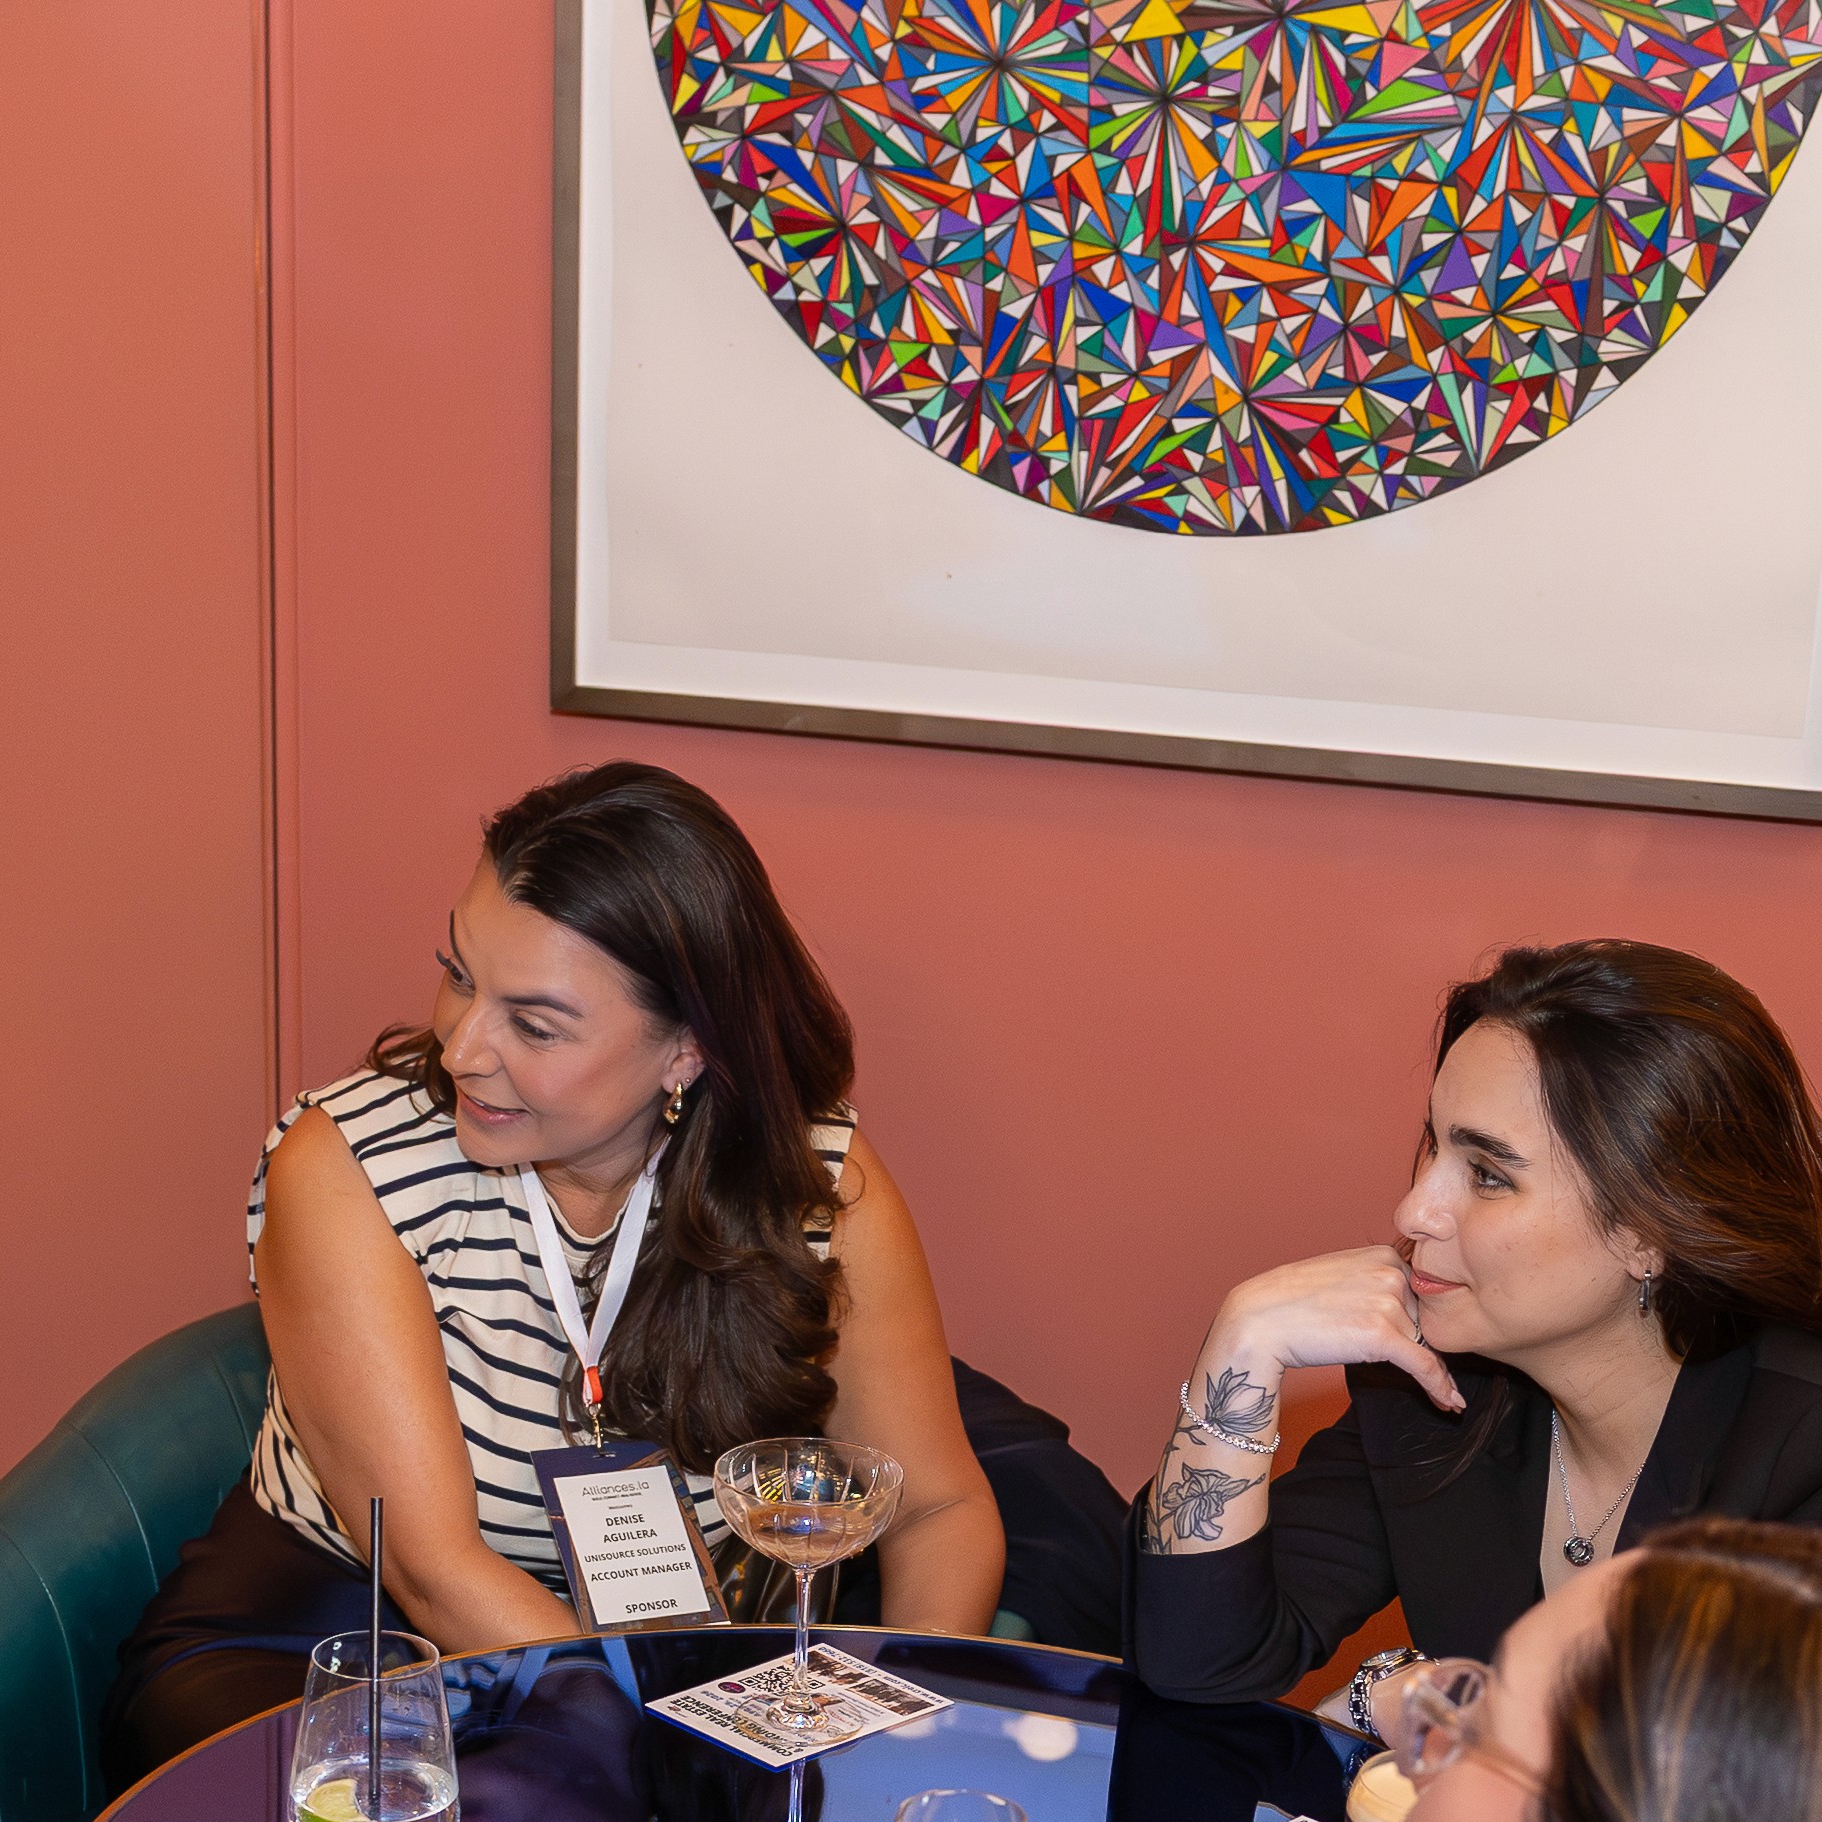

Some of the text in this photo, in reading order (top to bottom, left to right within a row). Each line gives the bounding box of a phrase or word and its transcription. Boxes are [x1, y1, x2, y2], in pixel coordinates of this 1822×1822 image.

[580, 1479, 650, 1497] Alliances.la
[604, 1513, 645, 1527] DENISE
[601, 1528, 658, 1543] AGUILERA
[583, 1543, 687, 1563] UNISOURCE SOLUTIONS
[589, 1561, 692, 1582] ACCOUNT MANAGER
[624, 1598, 678, 1613] SPONSOR
[668, 1698, 707, 1716] ESTATE
[702, 1714, 731, 1727] REAL
